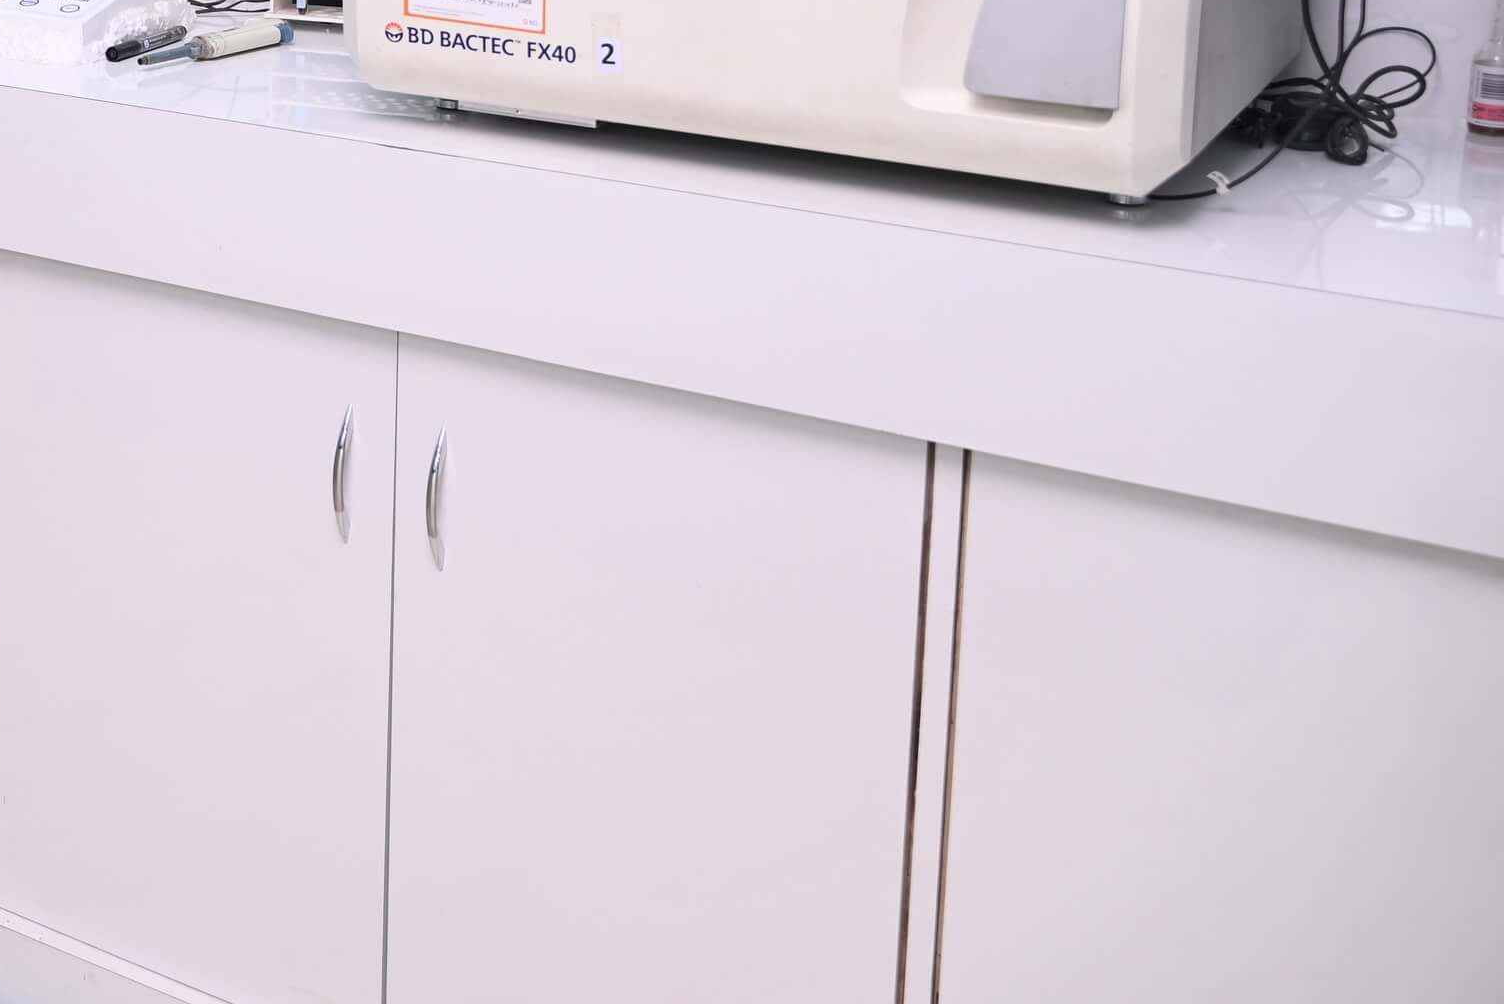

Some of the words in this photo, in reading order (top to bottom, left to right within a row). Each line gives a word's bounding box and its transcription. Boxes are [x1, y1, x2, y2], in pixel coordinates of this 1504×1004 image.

[407, 27, 434, 45] BD
[527, 41, 577, 64] FX40
[600, 43, 616, 65] 2
